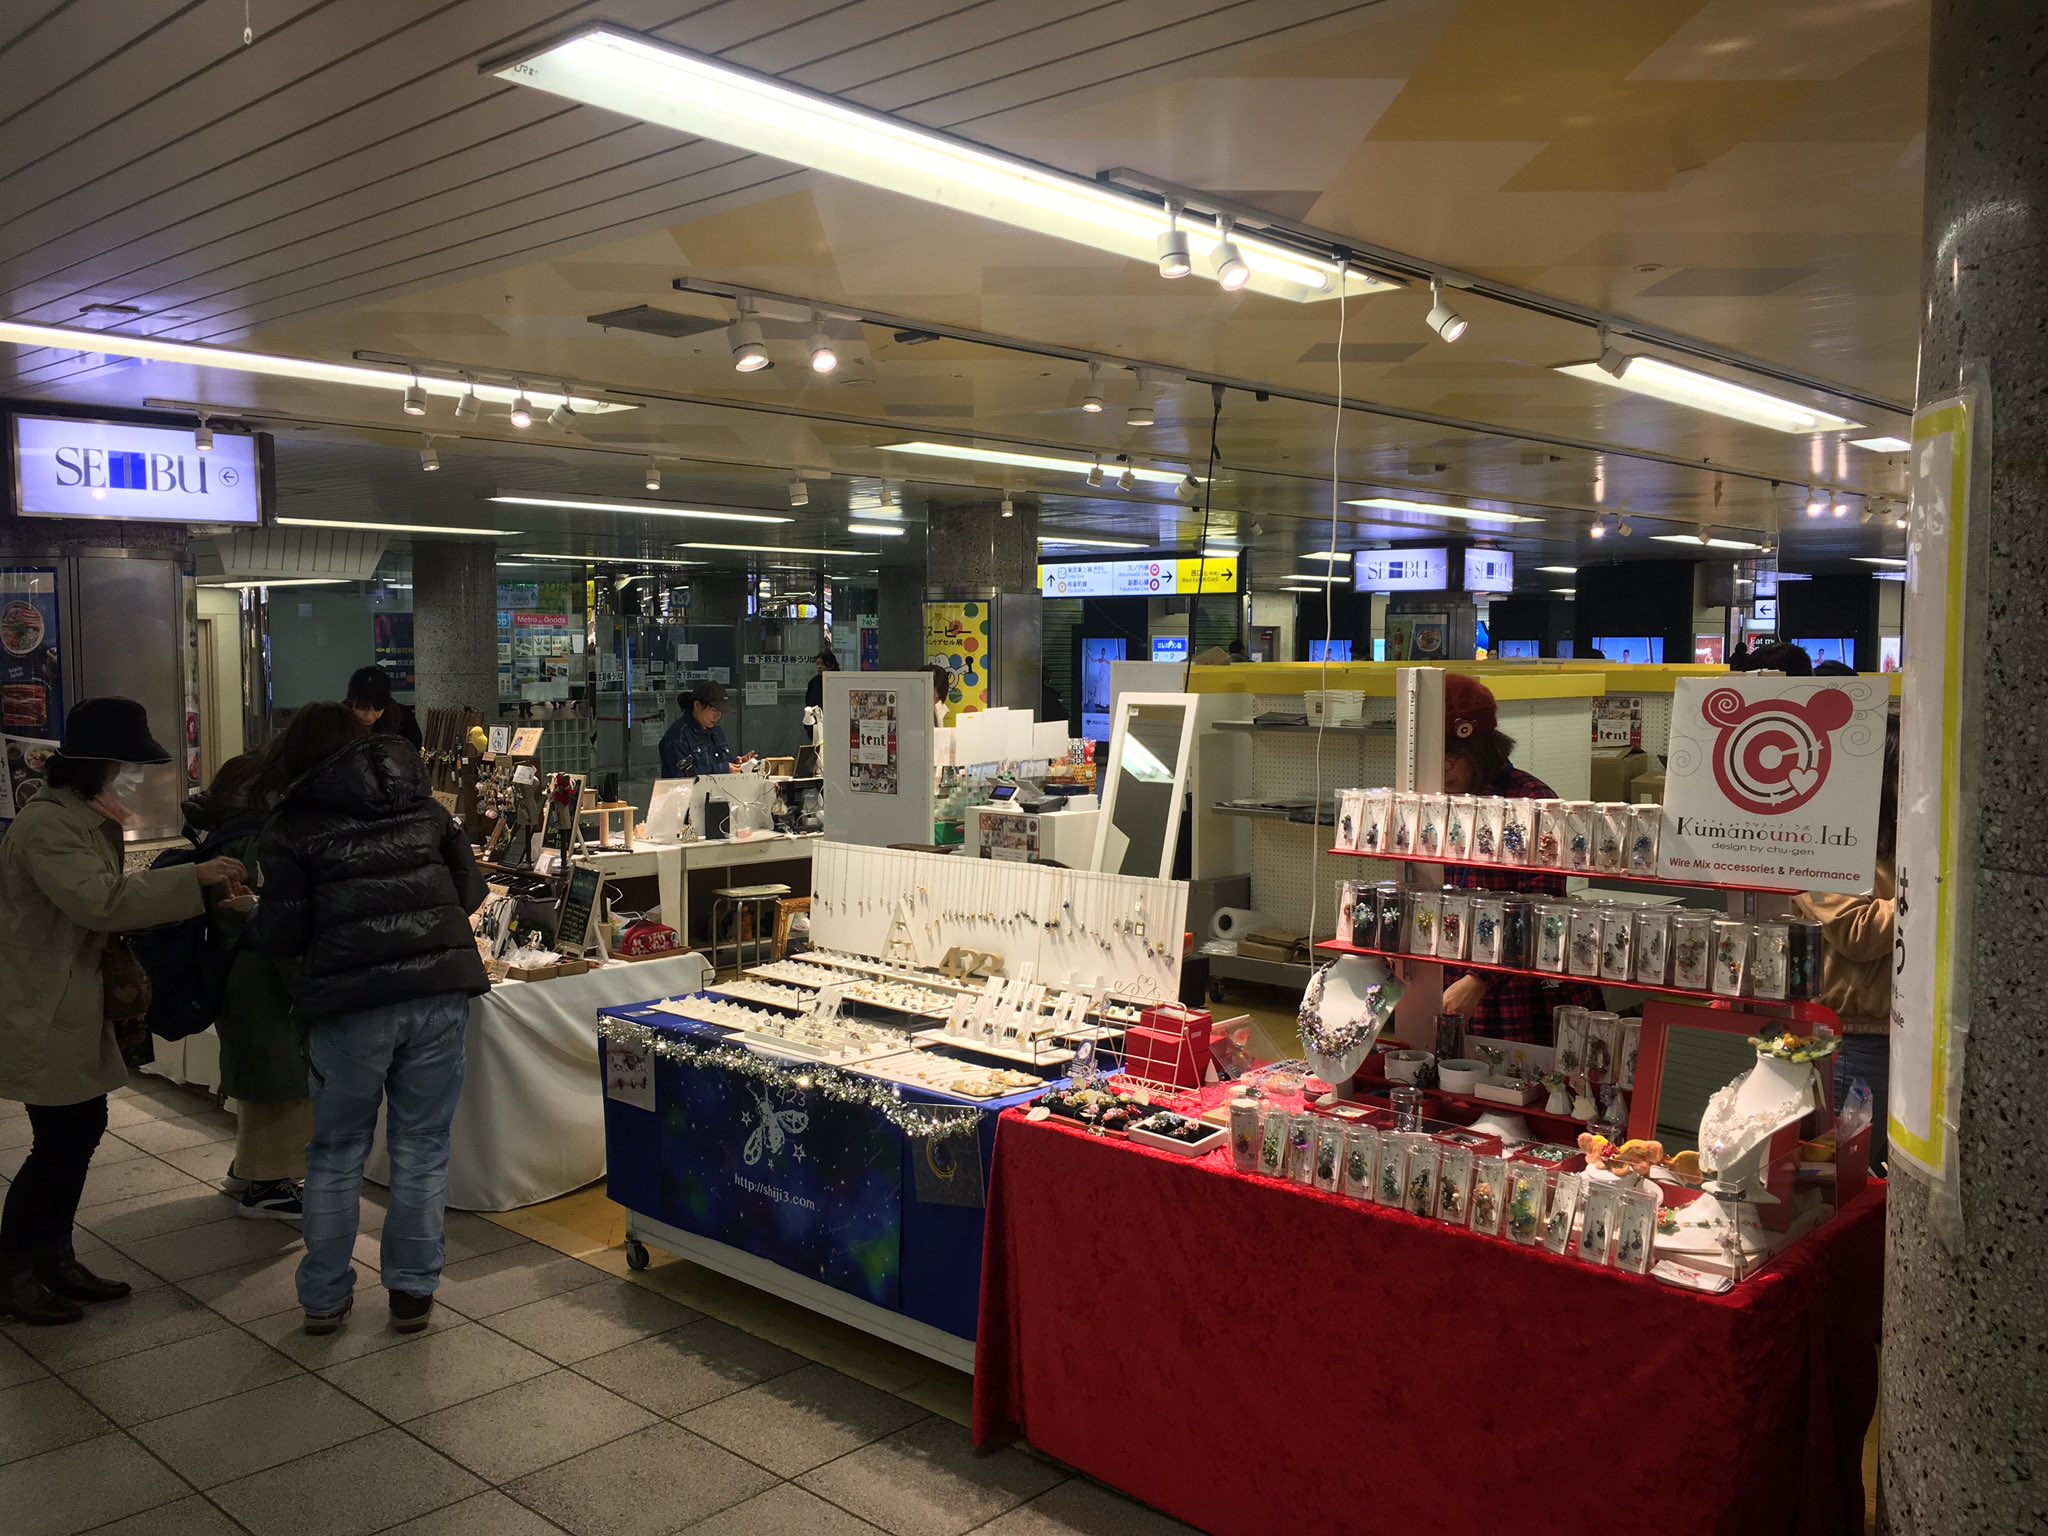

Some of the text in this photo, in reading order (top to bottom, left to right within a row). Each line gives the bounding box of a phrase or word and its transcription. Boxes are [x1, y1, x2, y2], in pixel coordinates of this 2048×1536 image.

[55, 446, 209, 494] SEIBU
[1367, 560, 1429, 580] SEIBU
[861, 733, 887, 746] tent
[1599, 730, 1628, 740] tent
[1711, 842, 1815, 856] design by chu-gen
[1669, 857, 1861, 882] Wire Mix accessories & Performance
[776, 1087, 807, 1107] 423
[734, 1172, 815, 1210] http://shiji3.com
